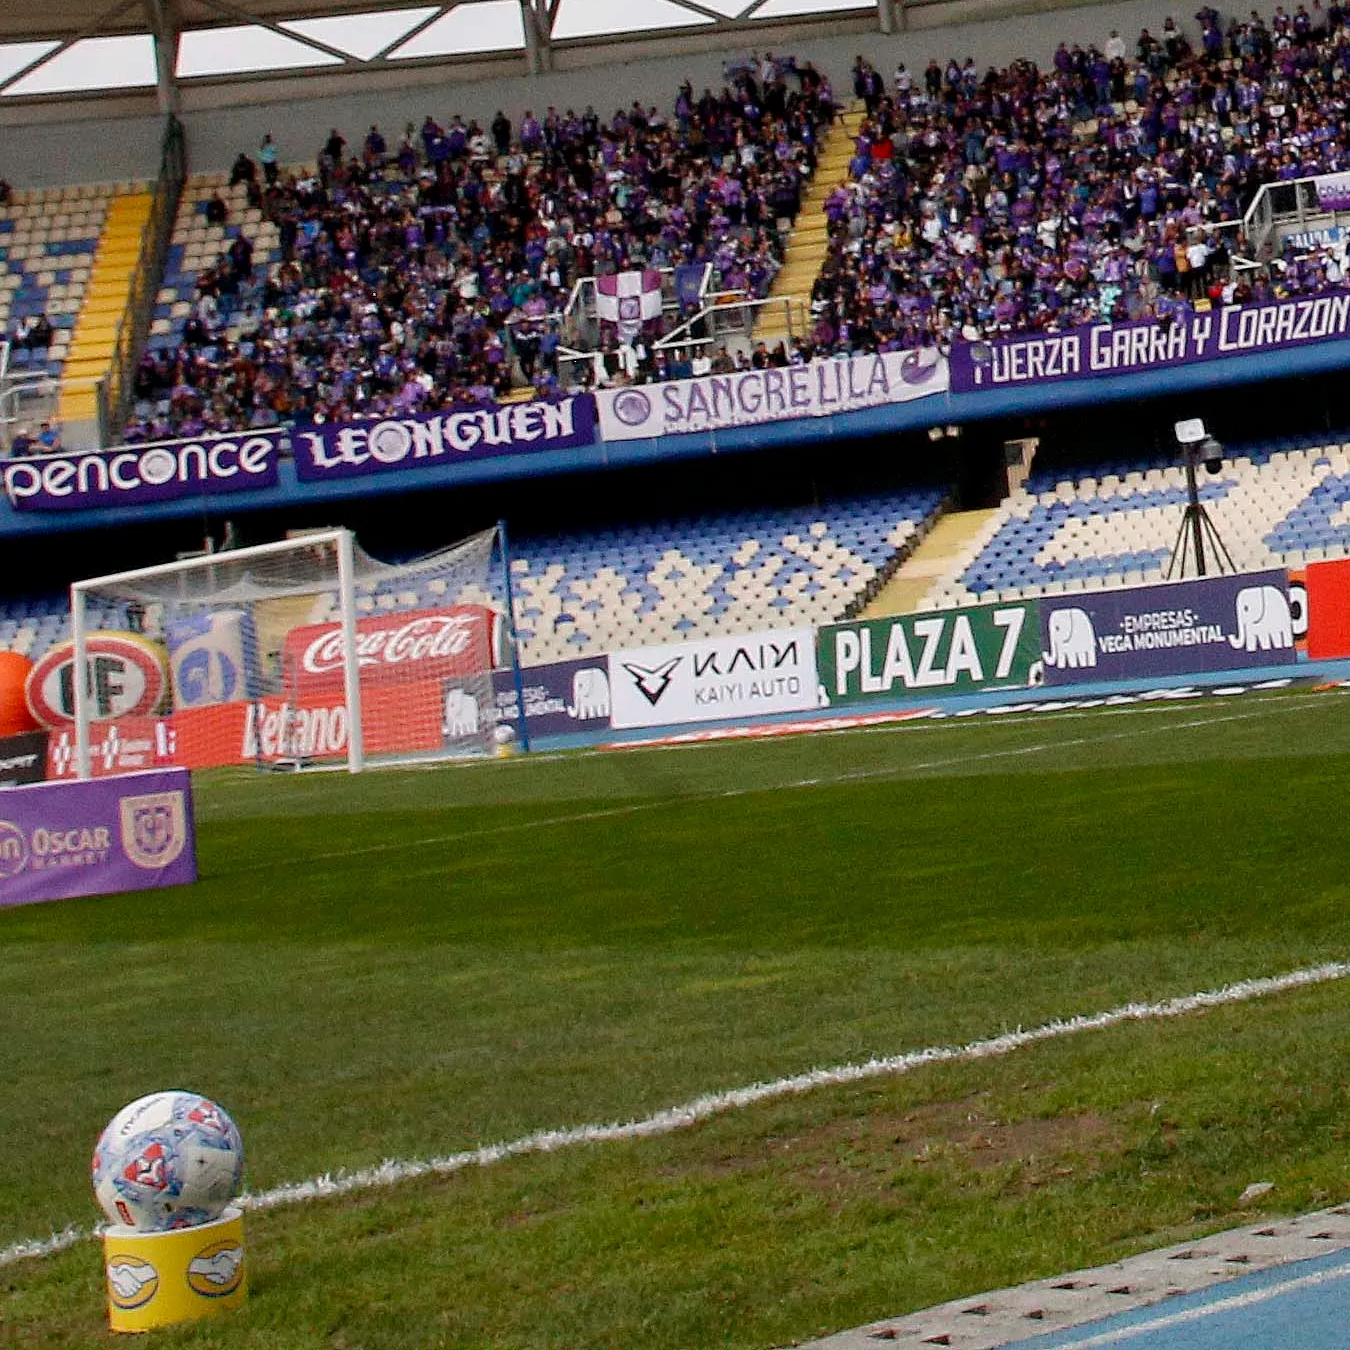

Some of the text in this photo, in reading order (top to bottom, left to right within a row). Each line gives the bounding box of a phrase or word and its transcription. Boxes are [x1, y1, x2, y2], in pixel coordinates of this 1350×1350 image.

[1121, 608, 1197, 634] EMPRESAS
[304, 615, 482, 674] Coca-Cola
[834, 607, 1027, 698] PLAZA 7
[1099, 625, 1225, 654] VEGA MONUMENTAL
[695, 675, 801, 706] KAIYI AUTO
